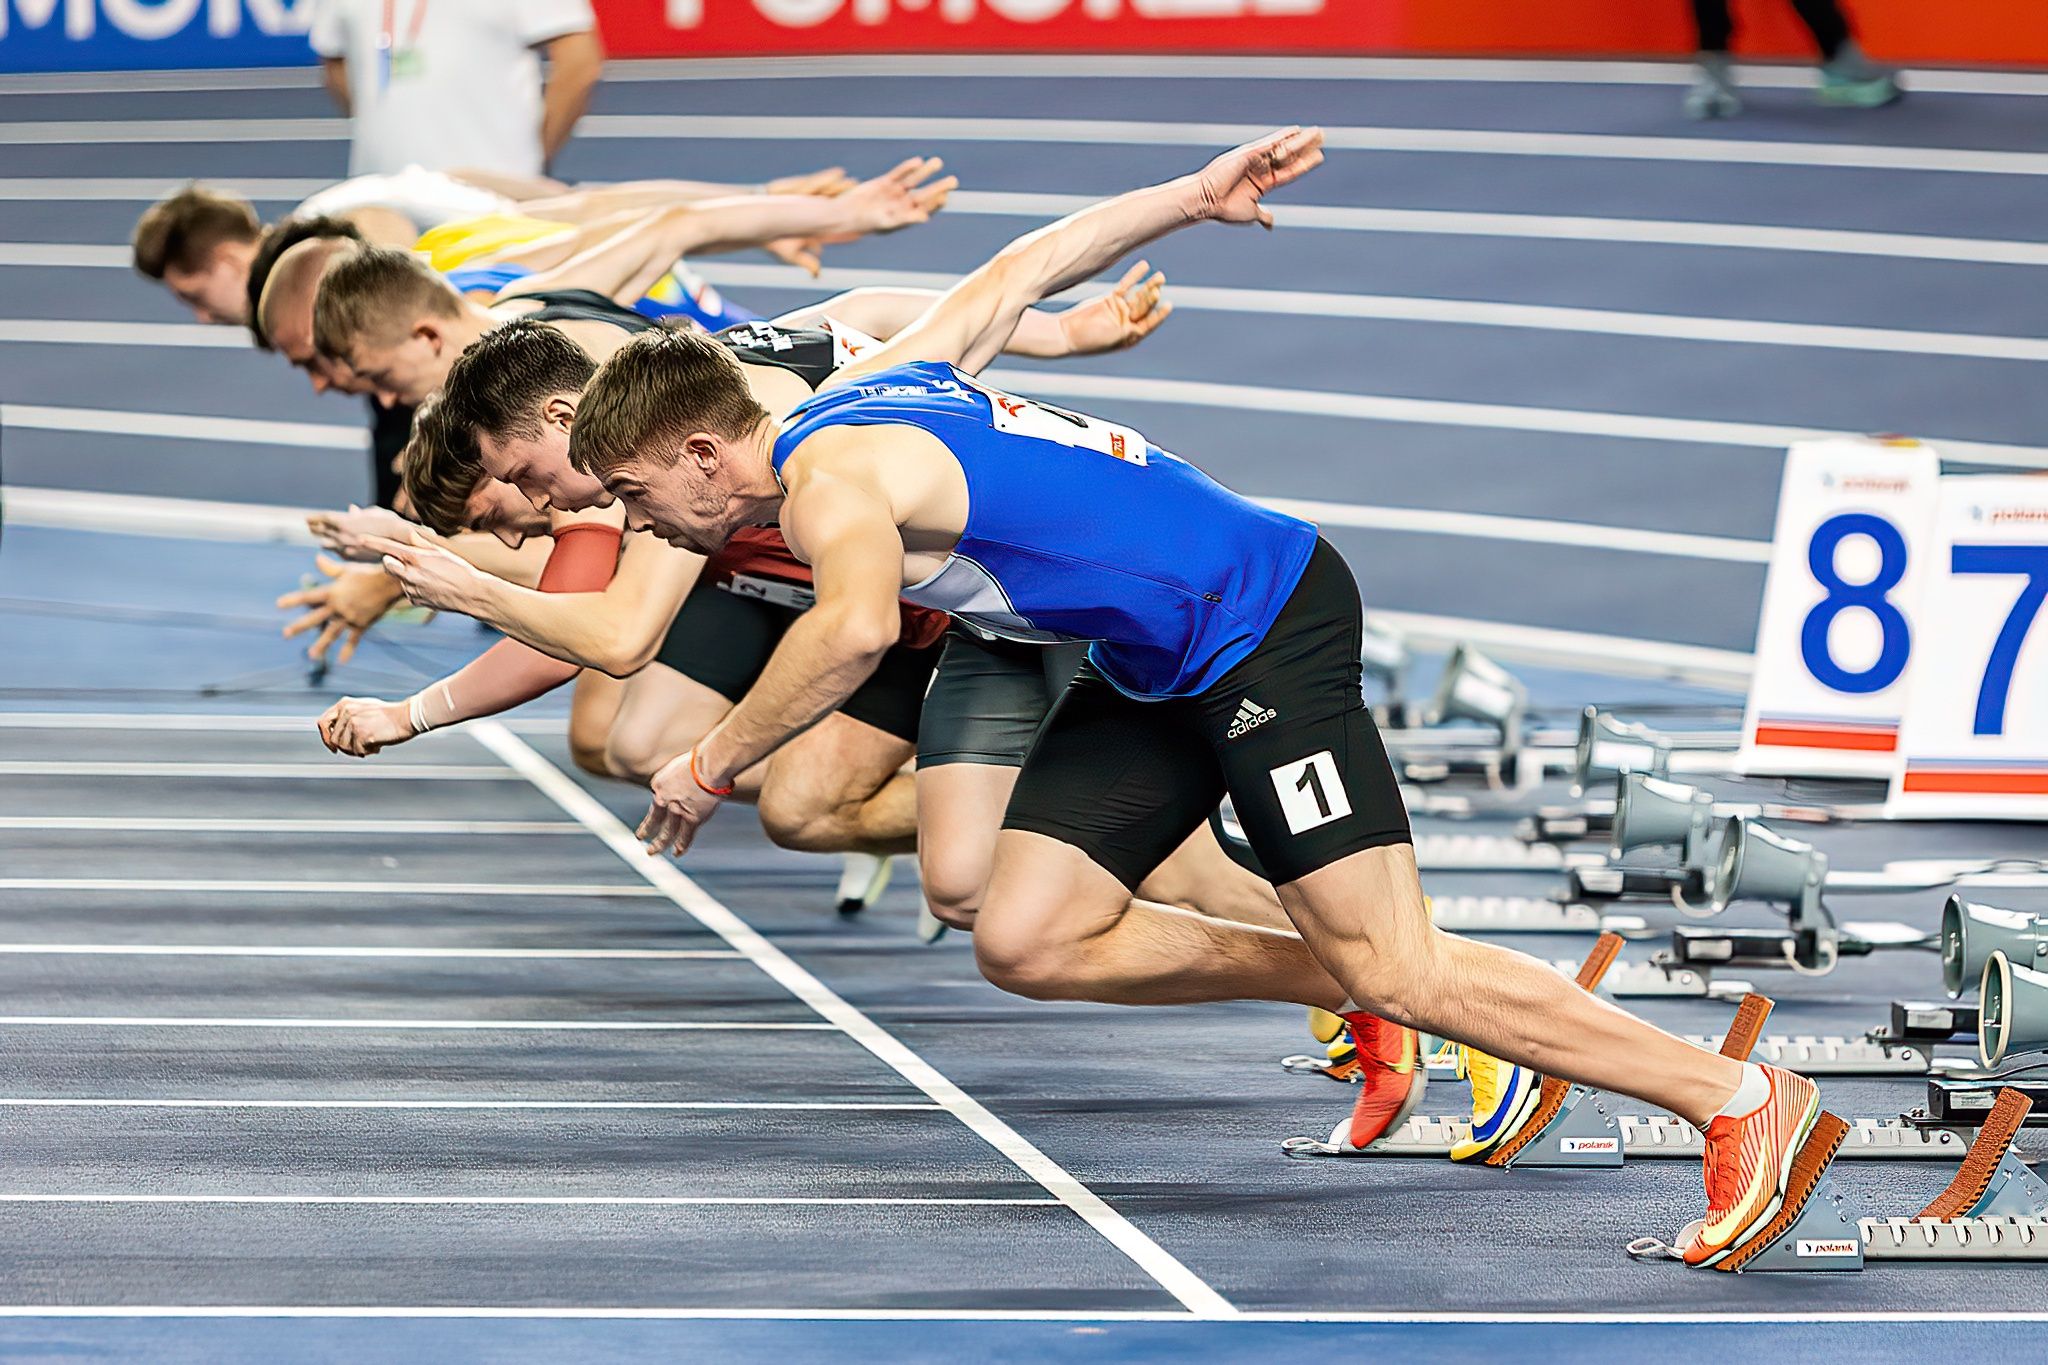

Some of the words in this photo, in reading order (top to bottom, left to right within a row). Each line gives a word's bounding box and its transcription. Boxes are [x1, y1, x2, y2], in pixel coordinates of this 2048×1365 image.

[1801, 513, 1911, 693] 8
[1951, 545, 2048, 735] 7
[1227, 707, 1278, 740] adidas
[1295, 761, 1333, 819] 1
[1577, 1140, 1615, 1151] polanik
[1815, 1242, 1854, 1255] polanik
